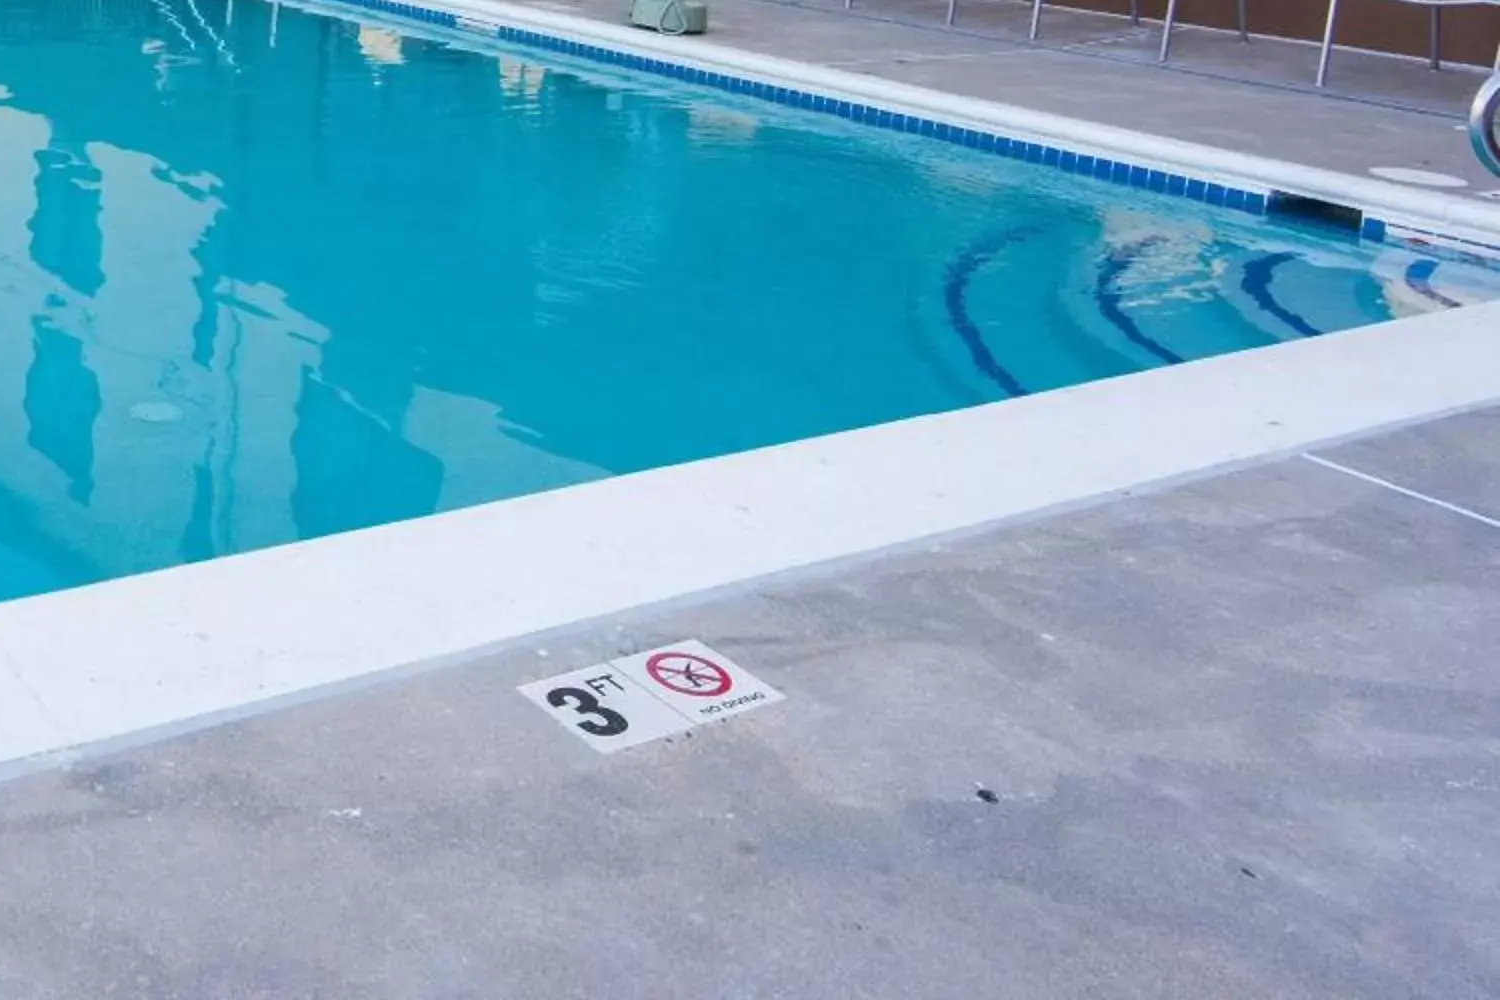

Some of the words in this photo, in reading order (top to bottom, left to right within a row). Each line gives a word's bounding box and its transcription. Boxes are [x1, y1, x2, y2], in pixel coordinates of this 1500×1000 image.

[585, 673, 625, 697] FT
[546, 686, 629, 737] 3
[699, 705, 722, 715] NO
[722, 692, 766, 709] DIVING
